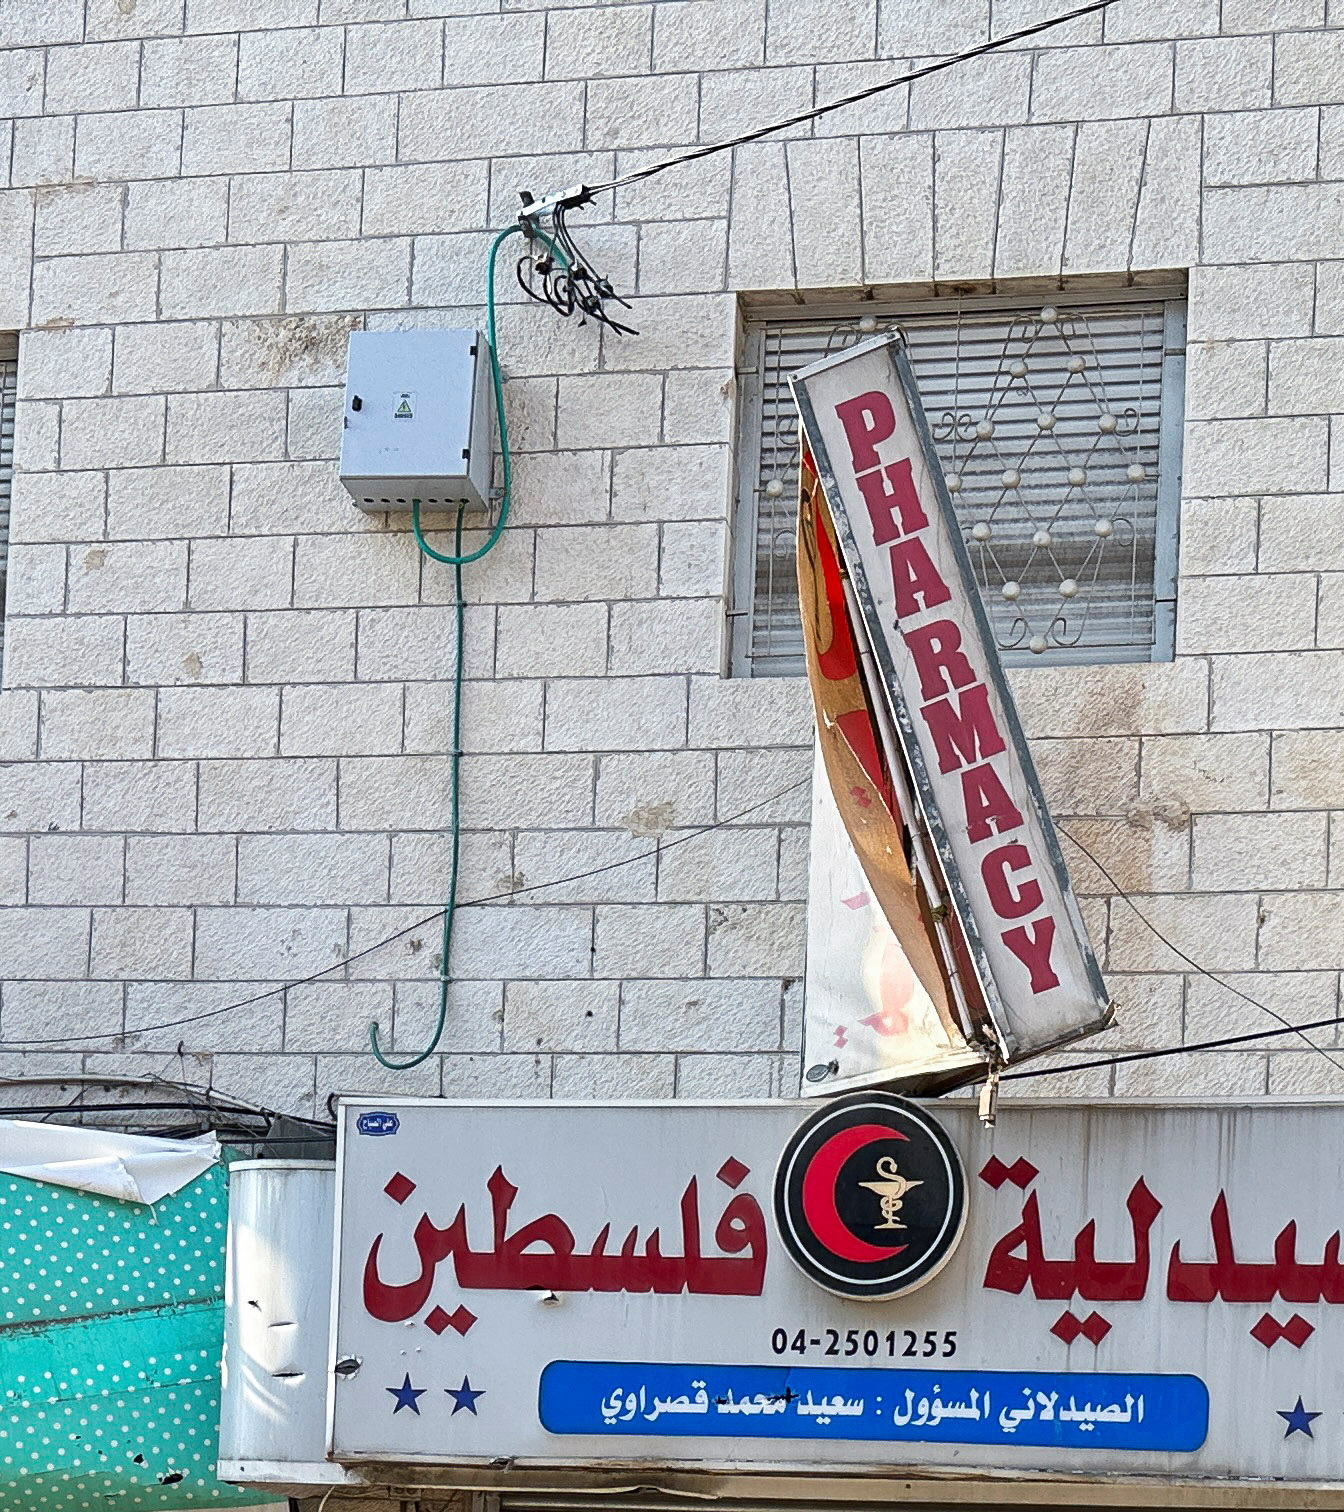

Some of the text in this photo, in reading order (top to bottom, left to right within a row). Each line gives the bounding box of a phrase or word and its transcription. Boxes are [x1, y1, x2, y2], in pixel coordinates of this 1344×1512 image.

[834, 390, 1061, 996] PHARMACY
[362, 1155, 768, 1335] فلسطين
[771, 1328, 958, 1358] 04-2501255
[601, 1380, 709, 1425] قصراوي
[714, 1388, 787, 1416] محمد
[796, 1389, 865, 1425] سعيد
[893, 1384, 991, 1426] المسؤول
[999, 1387, 1145, 1433] الصيدلاني
